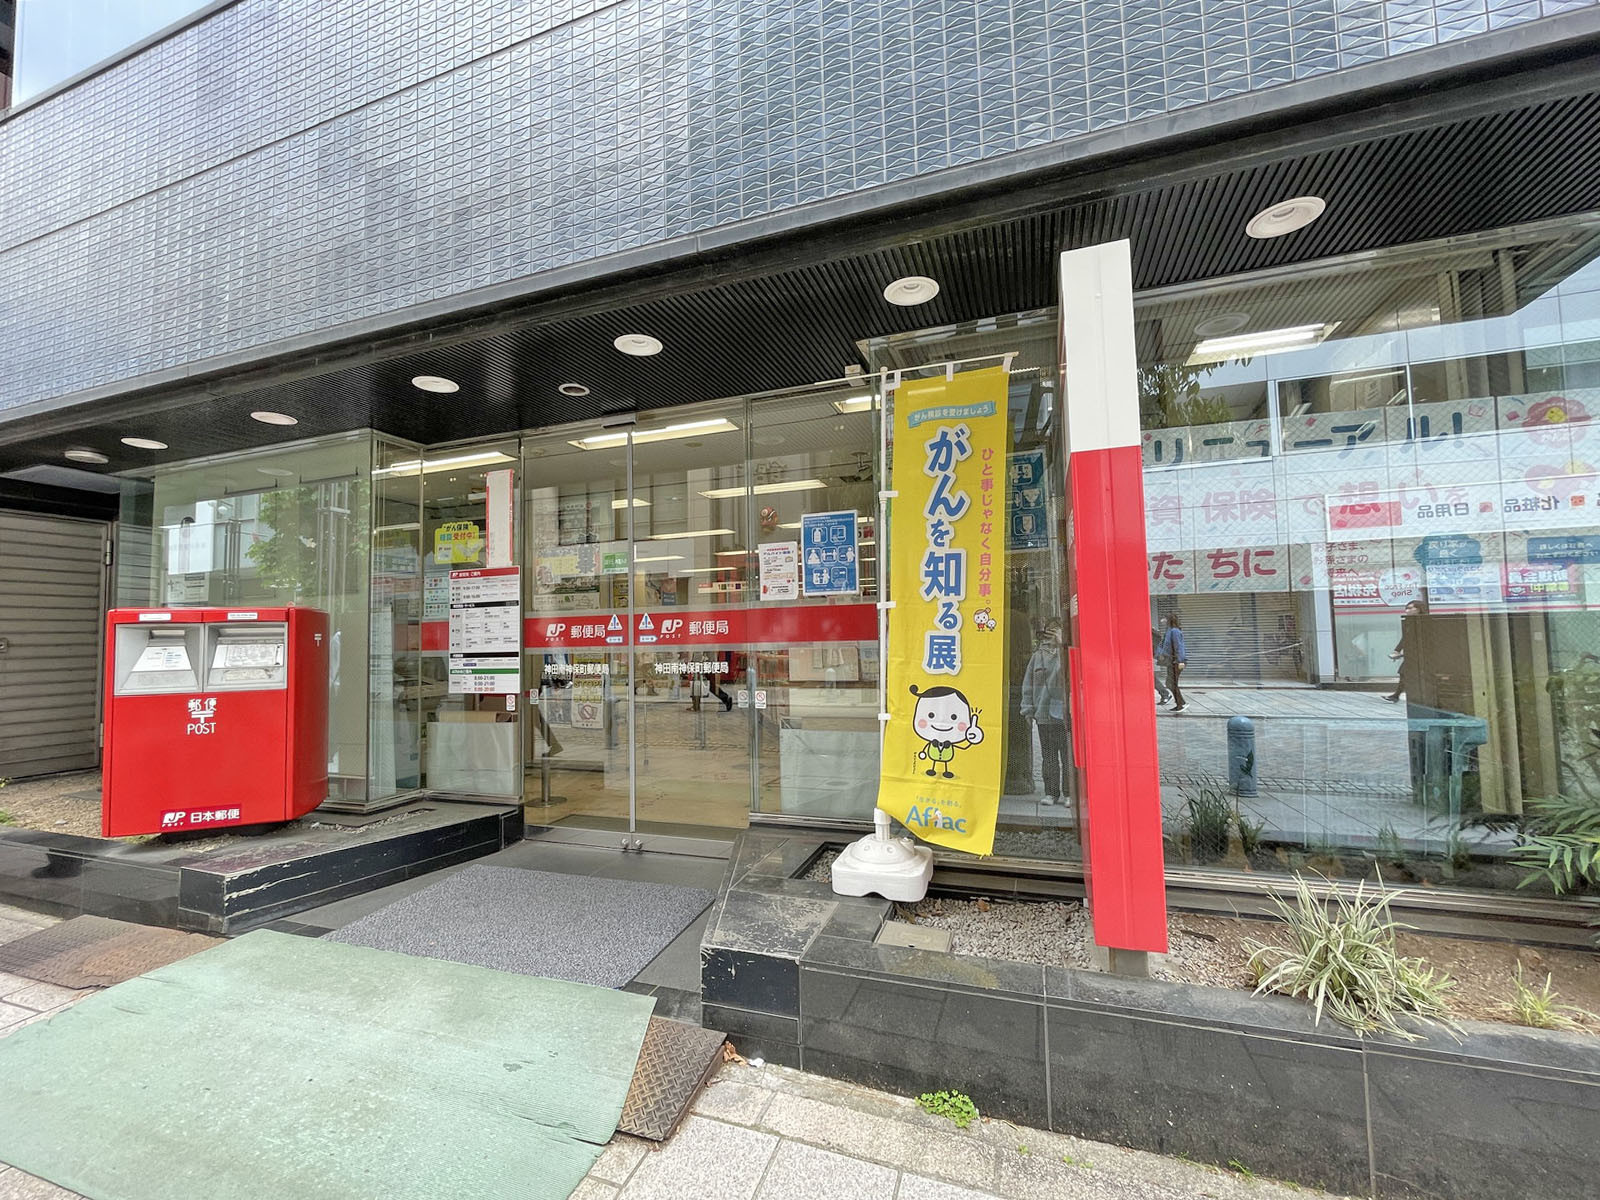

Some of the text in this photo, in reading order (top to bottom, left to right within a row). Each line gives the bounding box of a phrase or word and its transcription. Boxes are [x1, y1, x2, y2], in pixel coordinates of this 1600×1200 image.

[913, 404, 989, 422] がん検診を受けましょう
[978, 447, 994, 605] ひと事じゃなく自分事。
[923, 427, 969, 670] がんを知る展
[1147, 548, 1278, 580] たちに
[570, 624, 606, 639] 郵便局
[688, 619, 729, 636] 郵便局
[544, 663, 609, 675] 神田南神保町郵便局
[654, 661, 729, 674] 神田南神保町郵便局
[188, 698, 217, 712] 郵便
[187, 723, 217, 735] POST
[190, 808, 240, 823] 日本郵便
[905, 805, 967, 833] Aflac
